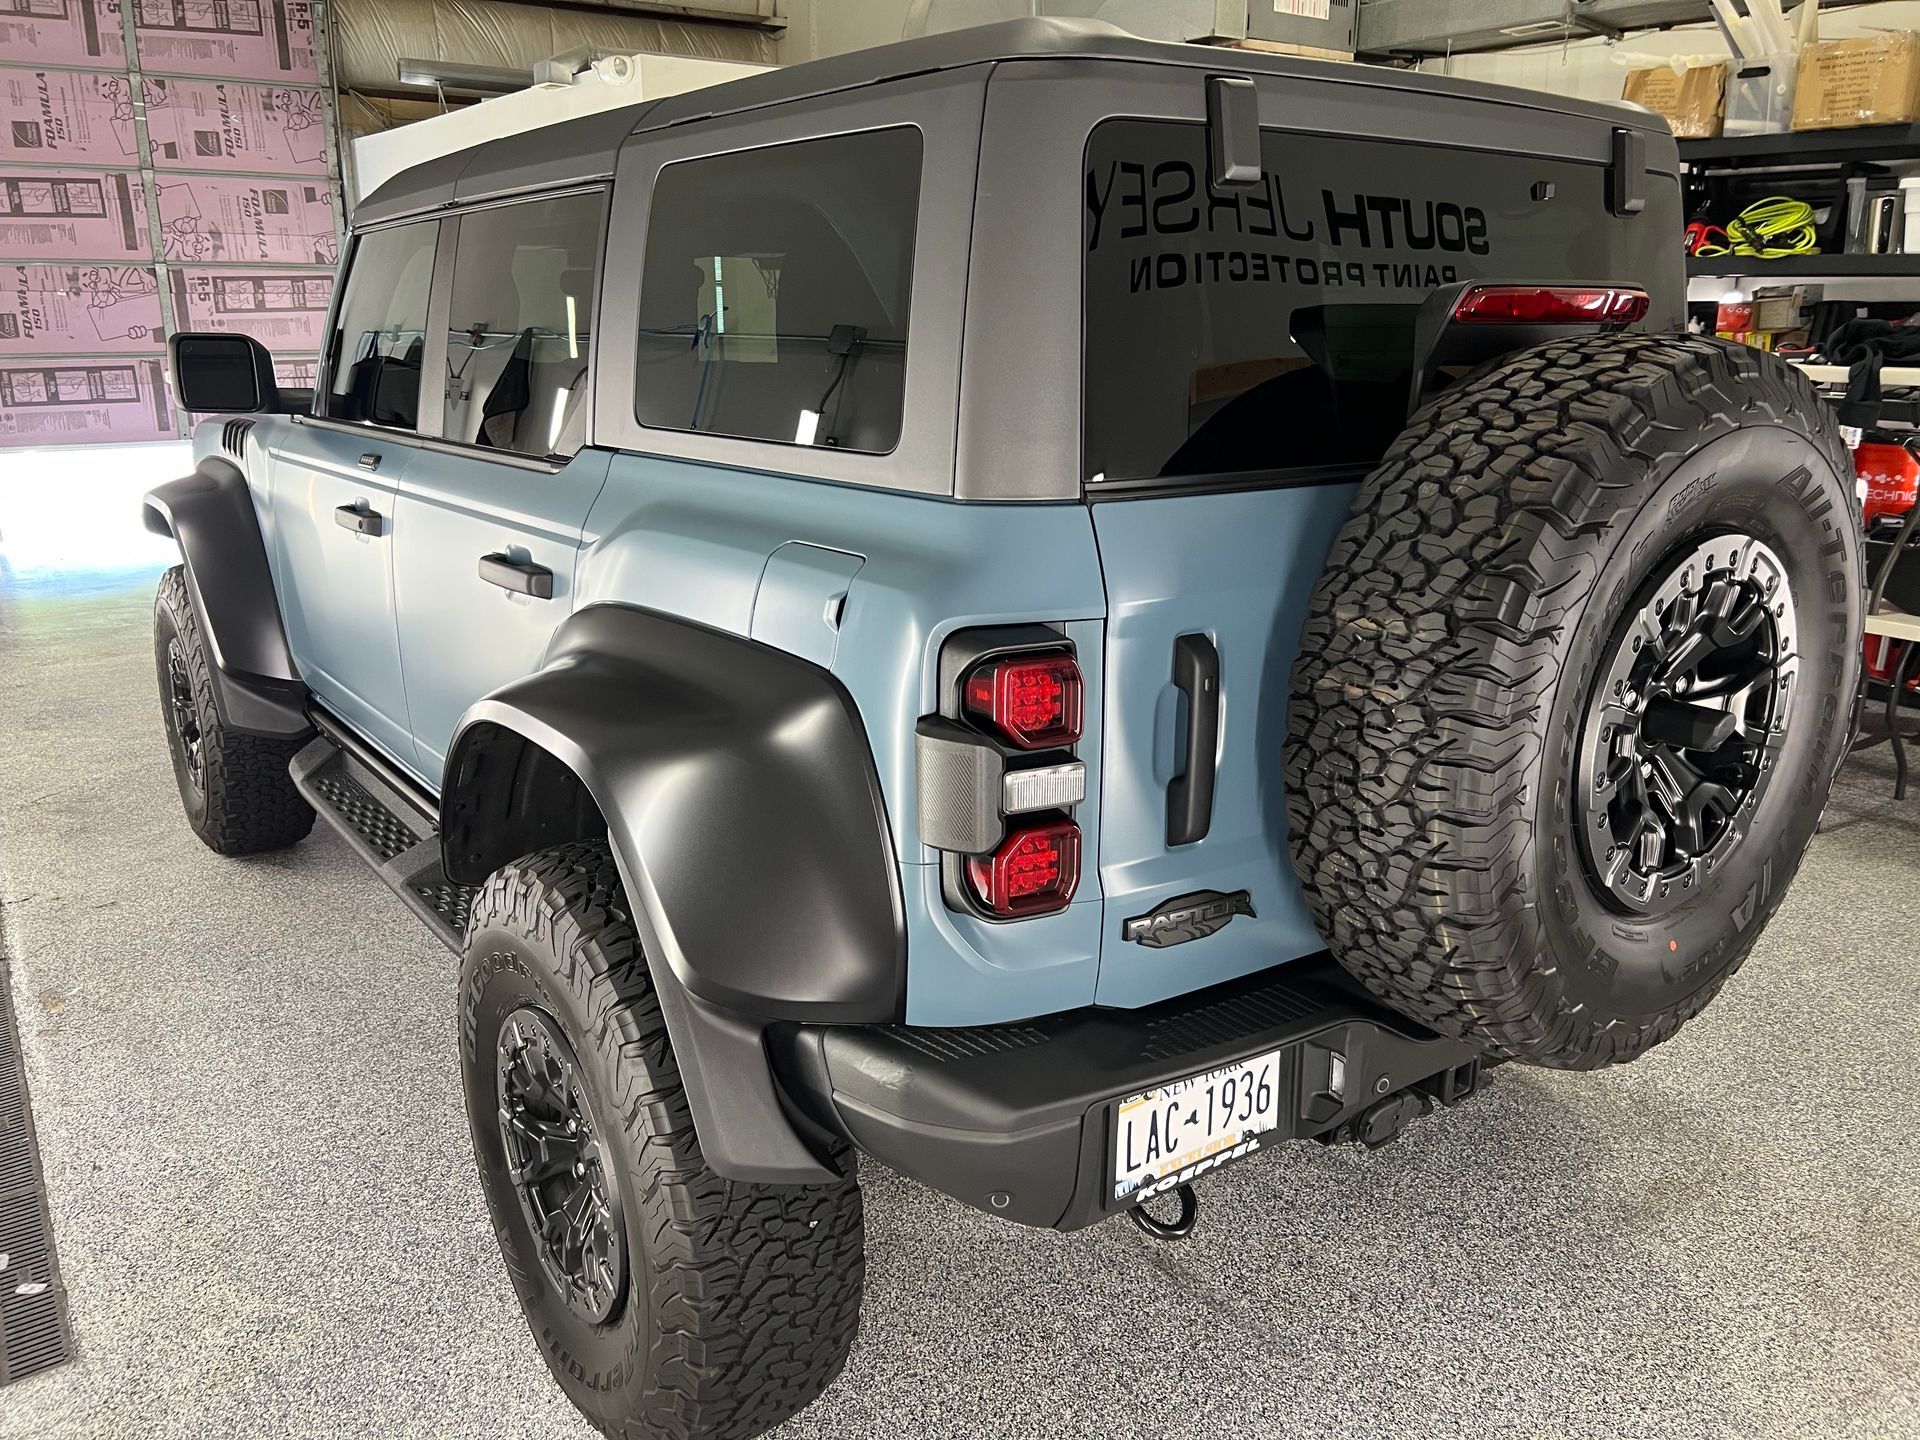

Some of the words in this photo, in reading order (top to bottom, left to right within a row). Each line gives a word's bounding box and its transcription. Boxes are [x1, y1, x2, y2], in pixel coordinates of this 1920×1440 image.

[296, 1, 309, 30] R-5
[55, 118, 66, 140] 150
[233, 128, 243, 149] 150
[242, 197, 251, 218] 150
[196, 276, 210, 303] R-5
[32, 308, 42, 330] 150
[1130, 892, 1256, 941] RAPTOR
[1160, 1077, 1196, 1101] NEW
[1127, 1101, 1179, 1172] LAC
[1205, 1064, 1270, 1136] 1936
[1136, 1138, 1260, 1202] KOEPPEL
